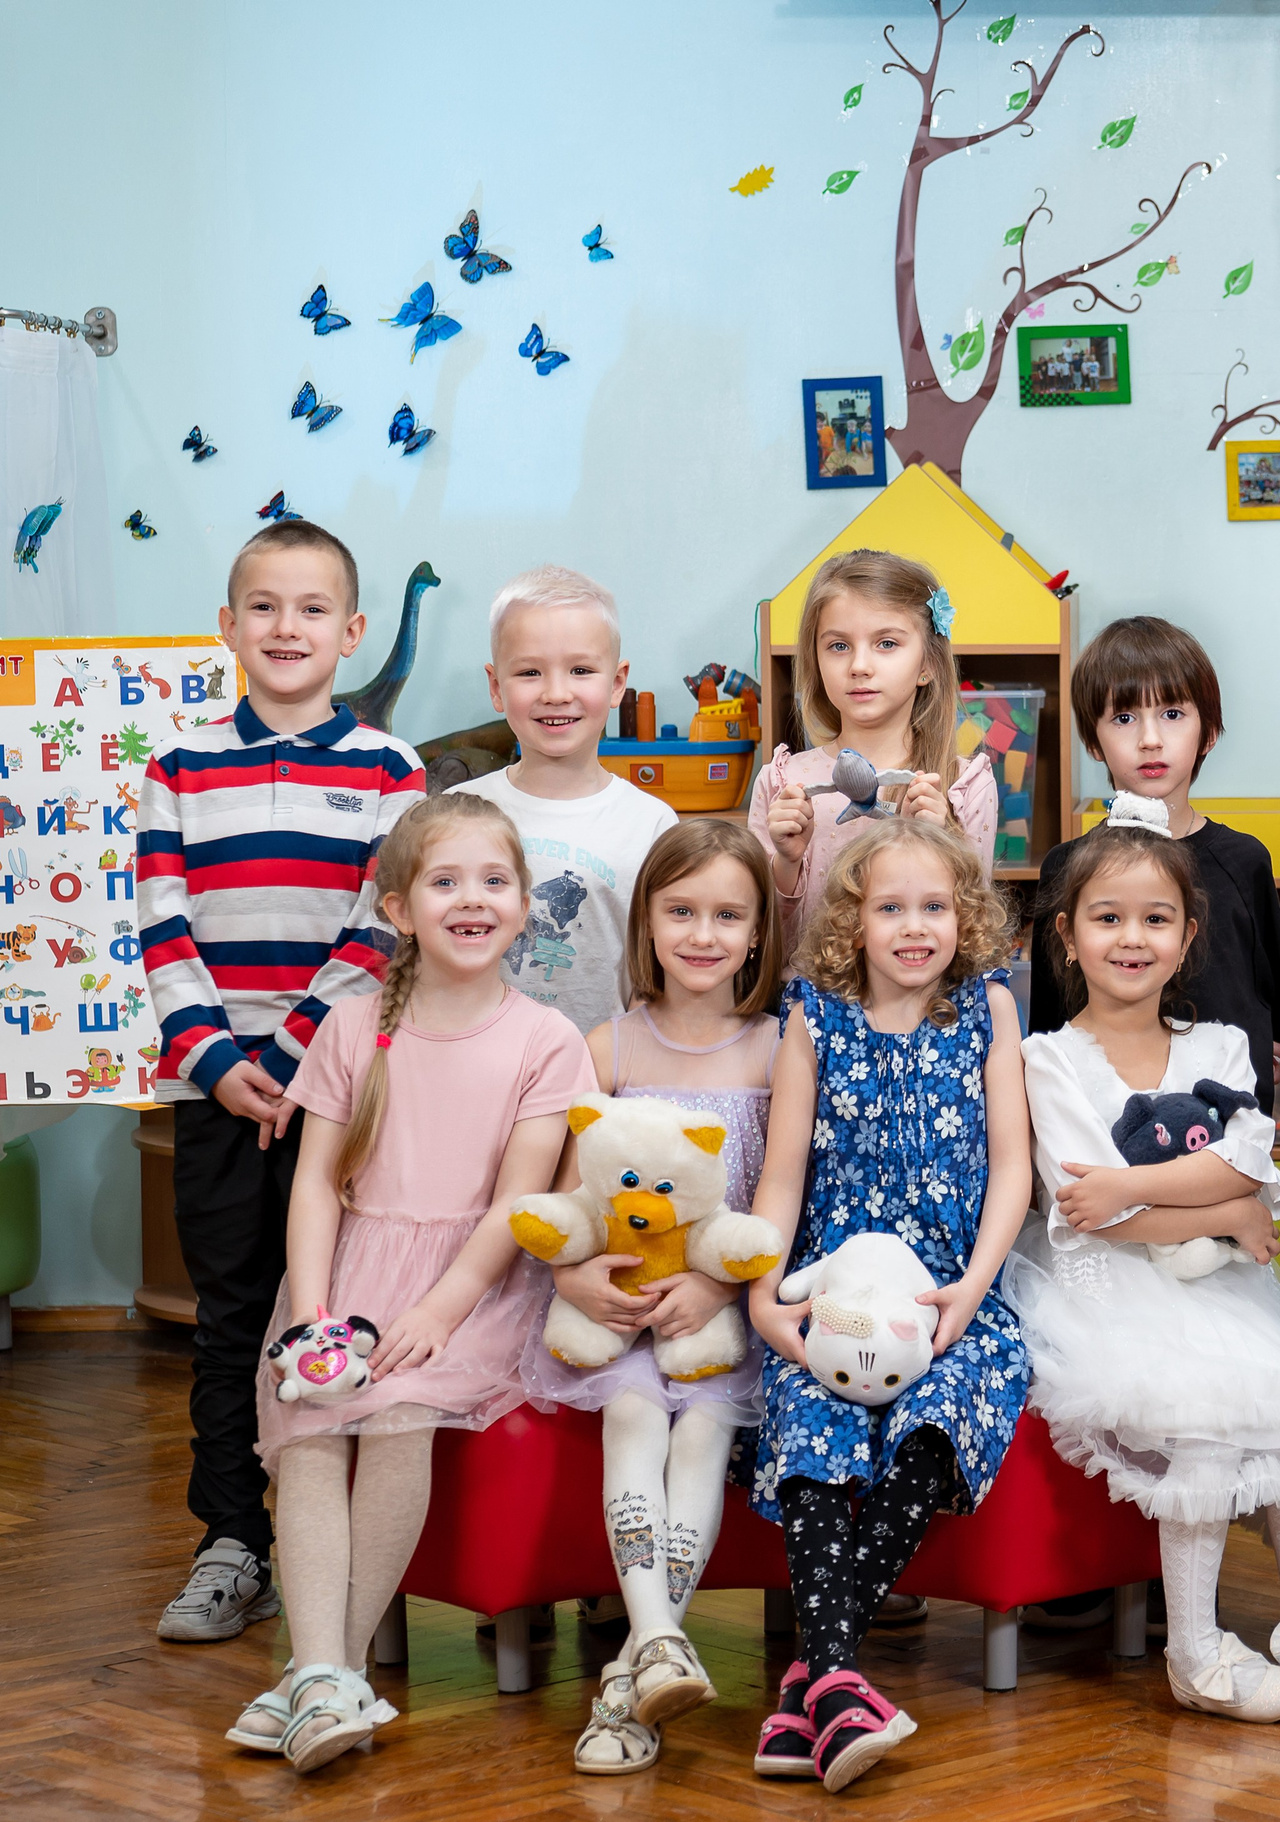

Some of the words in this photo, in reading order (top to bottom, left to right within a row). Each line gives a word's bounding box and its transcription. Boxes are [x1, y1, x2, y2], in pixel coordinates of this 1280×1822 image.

[53, 677, 84, 707] А
[119, 676, 145, 705] Б
[181, 675, 207, 704] В
[41, 743, 61, 772] Е
[100, 734, 120, 771] Ё
[37, 798, 67, 836] Й
[103, 806, 130, 835] К
[521, 837, 569, 861] EVER
[575, 847, 616, 889] ENDS
[50, 872, 82, 903] О
[106, 871, 134, 901] П
[46, 938, 75, 968] У
[109, 934, 142, 965] Ф
[539, 993, 558, 1002] DAY
[4, 1006, 30, 1035] Ч
[78, 1002, 119, 1033] Ш
[25, 1071, 52, 1100] Ь
[66, 1069, 90, 1098] Э
